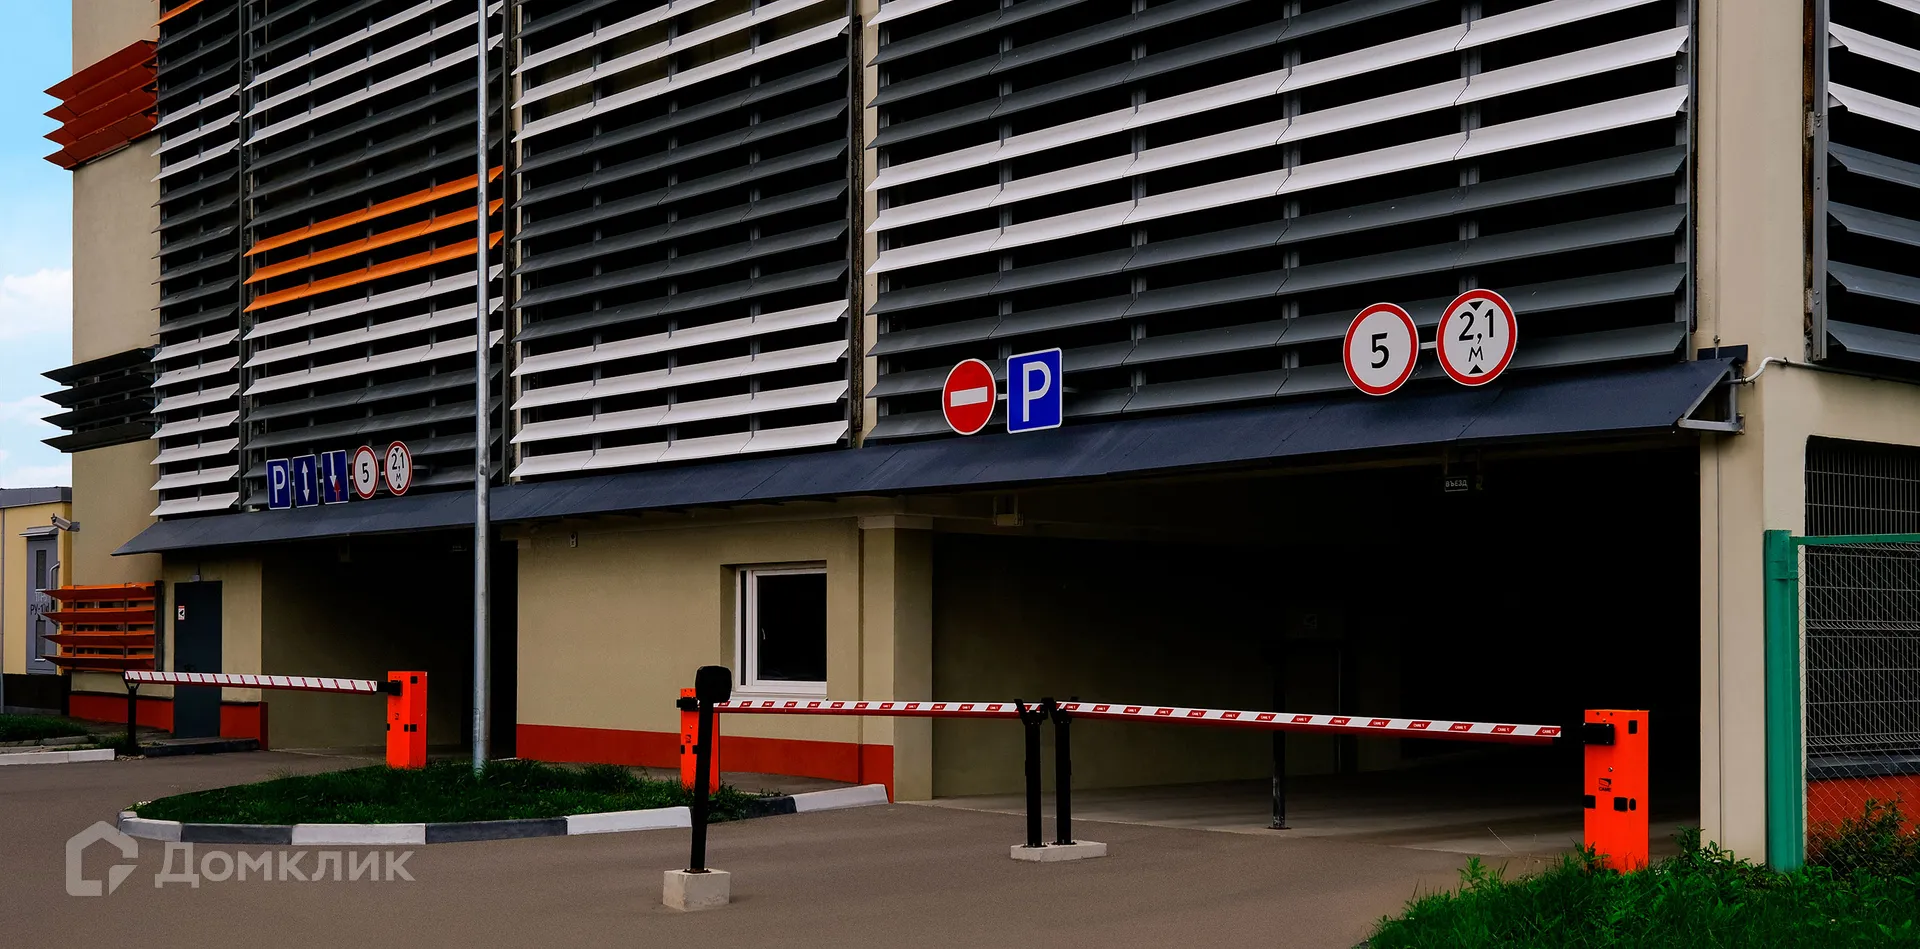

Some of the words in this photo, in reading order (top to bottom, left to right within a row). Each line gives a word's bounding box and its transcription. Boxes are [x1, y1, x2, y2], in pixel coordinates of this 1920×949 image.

[1458, 308, 1494, 345] 2,1
[1370, 332, 1390, 369] 5
[1022, 360, 1052, 422] P
[361, 461, 370, 484] 5
[391, 451, 405, 472] 2,1
[272, 465, 286, 504] P
